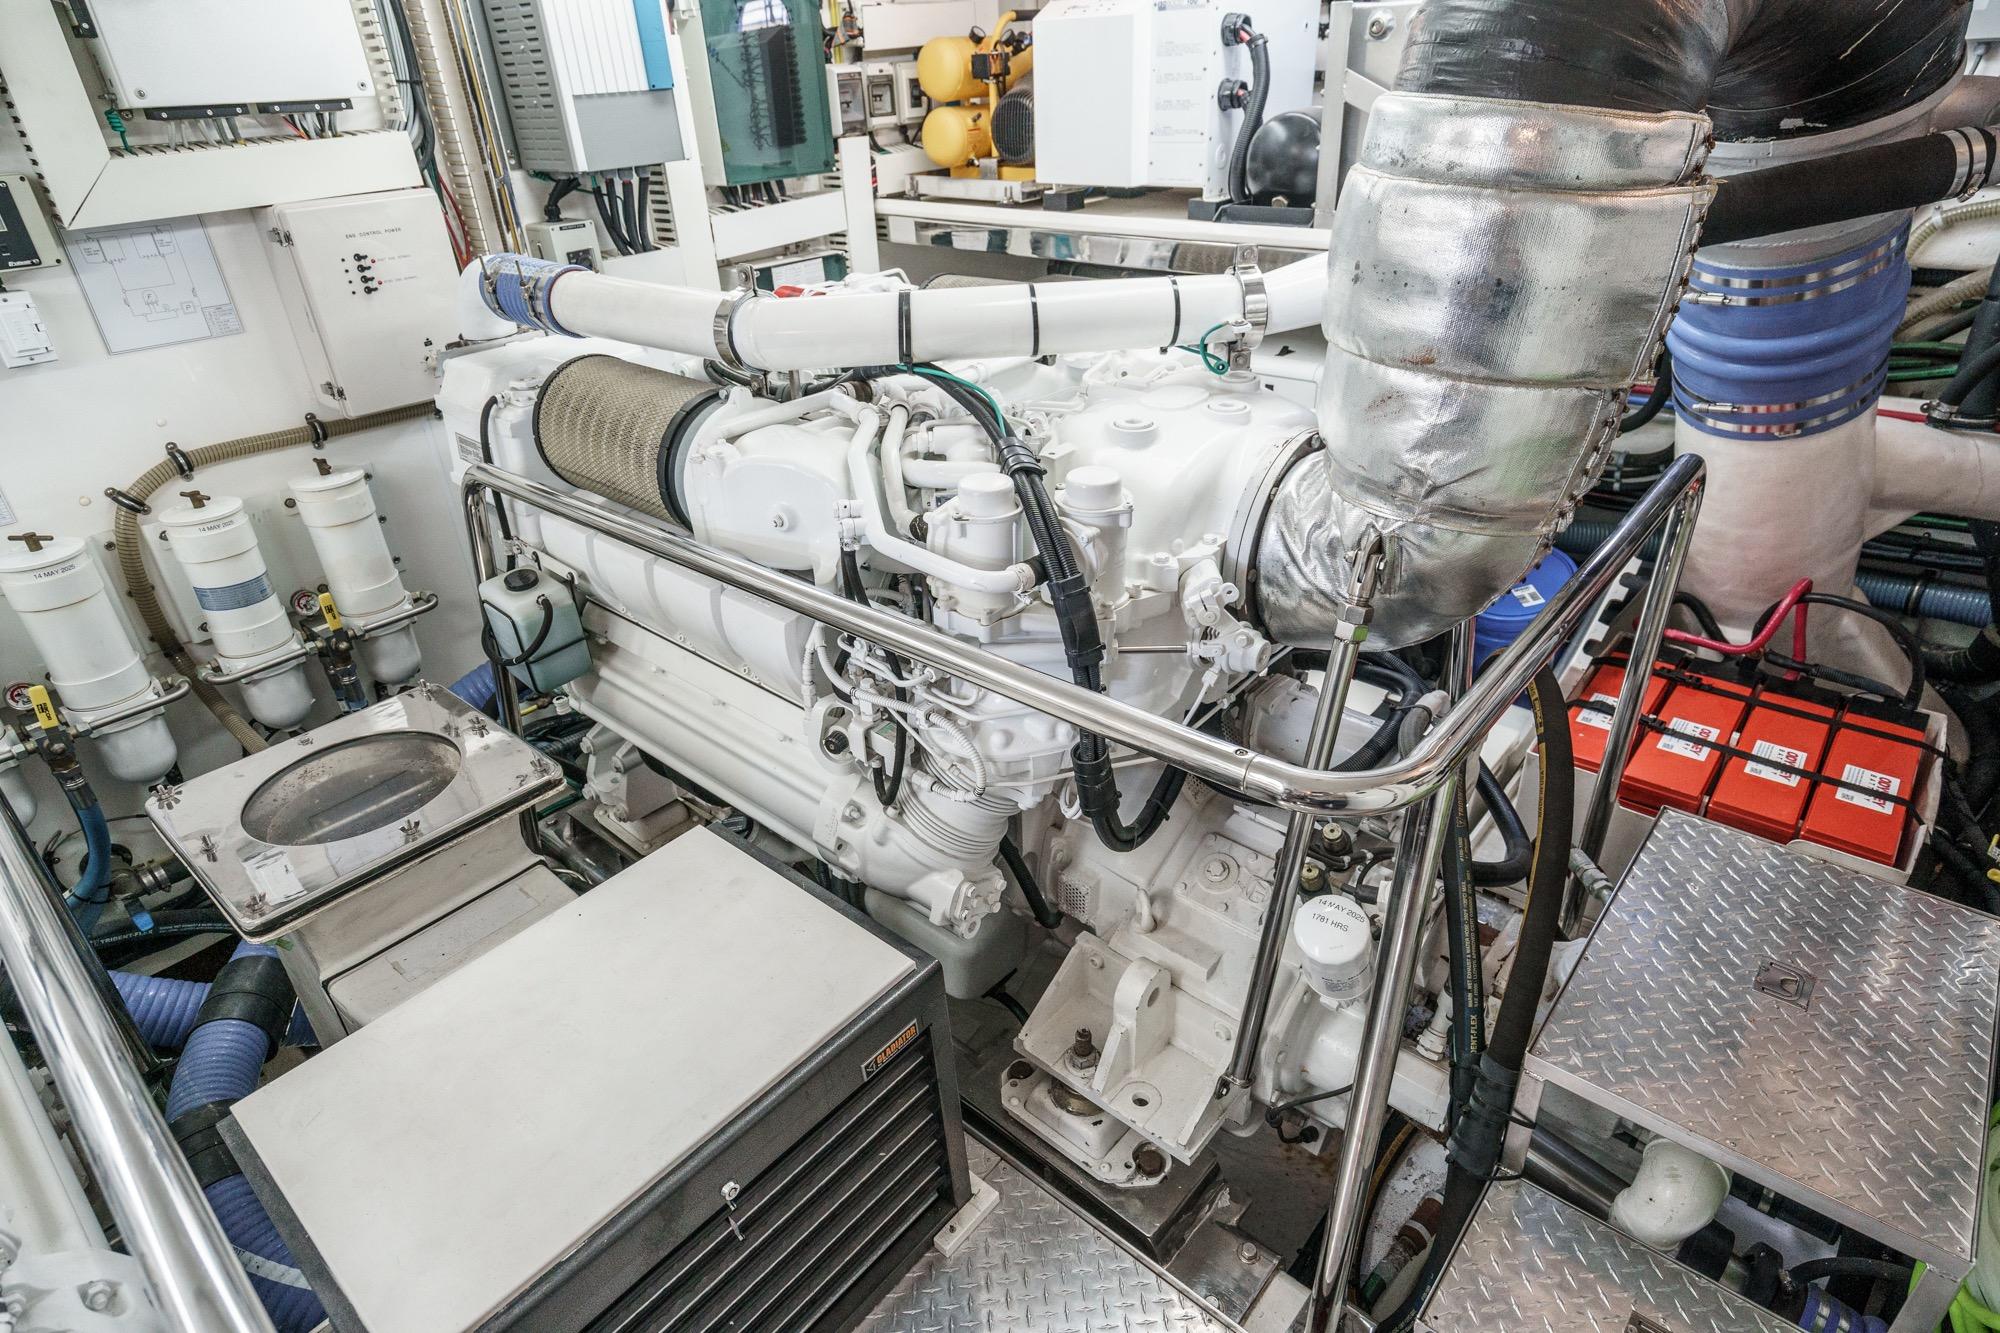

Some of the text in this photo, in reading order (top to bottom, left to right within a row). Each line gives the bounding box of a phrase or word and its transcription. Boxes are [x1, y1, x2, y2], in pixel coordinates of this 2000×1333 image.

[359, 230, 383, 238] CONTROL
[384, 226, 402, 234] POWER
[207, 523, 221, 531] MAY
[43, 569, 59, 577] MAY
[60, 563, 76, 573] 2025
[1327, 901, 1346, 912] MAY
[1346, 909, 1365, 923] 2025
[1312, 913, 1349, 932] 1781 HRS
[876, 1025, 916, 1064] GLADIATOR
